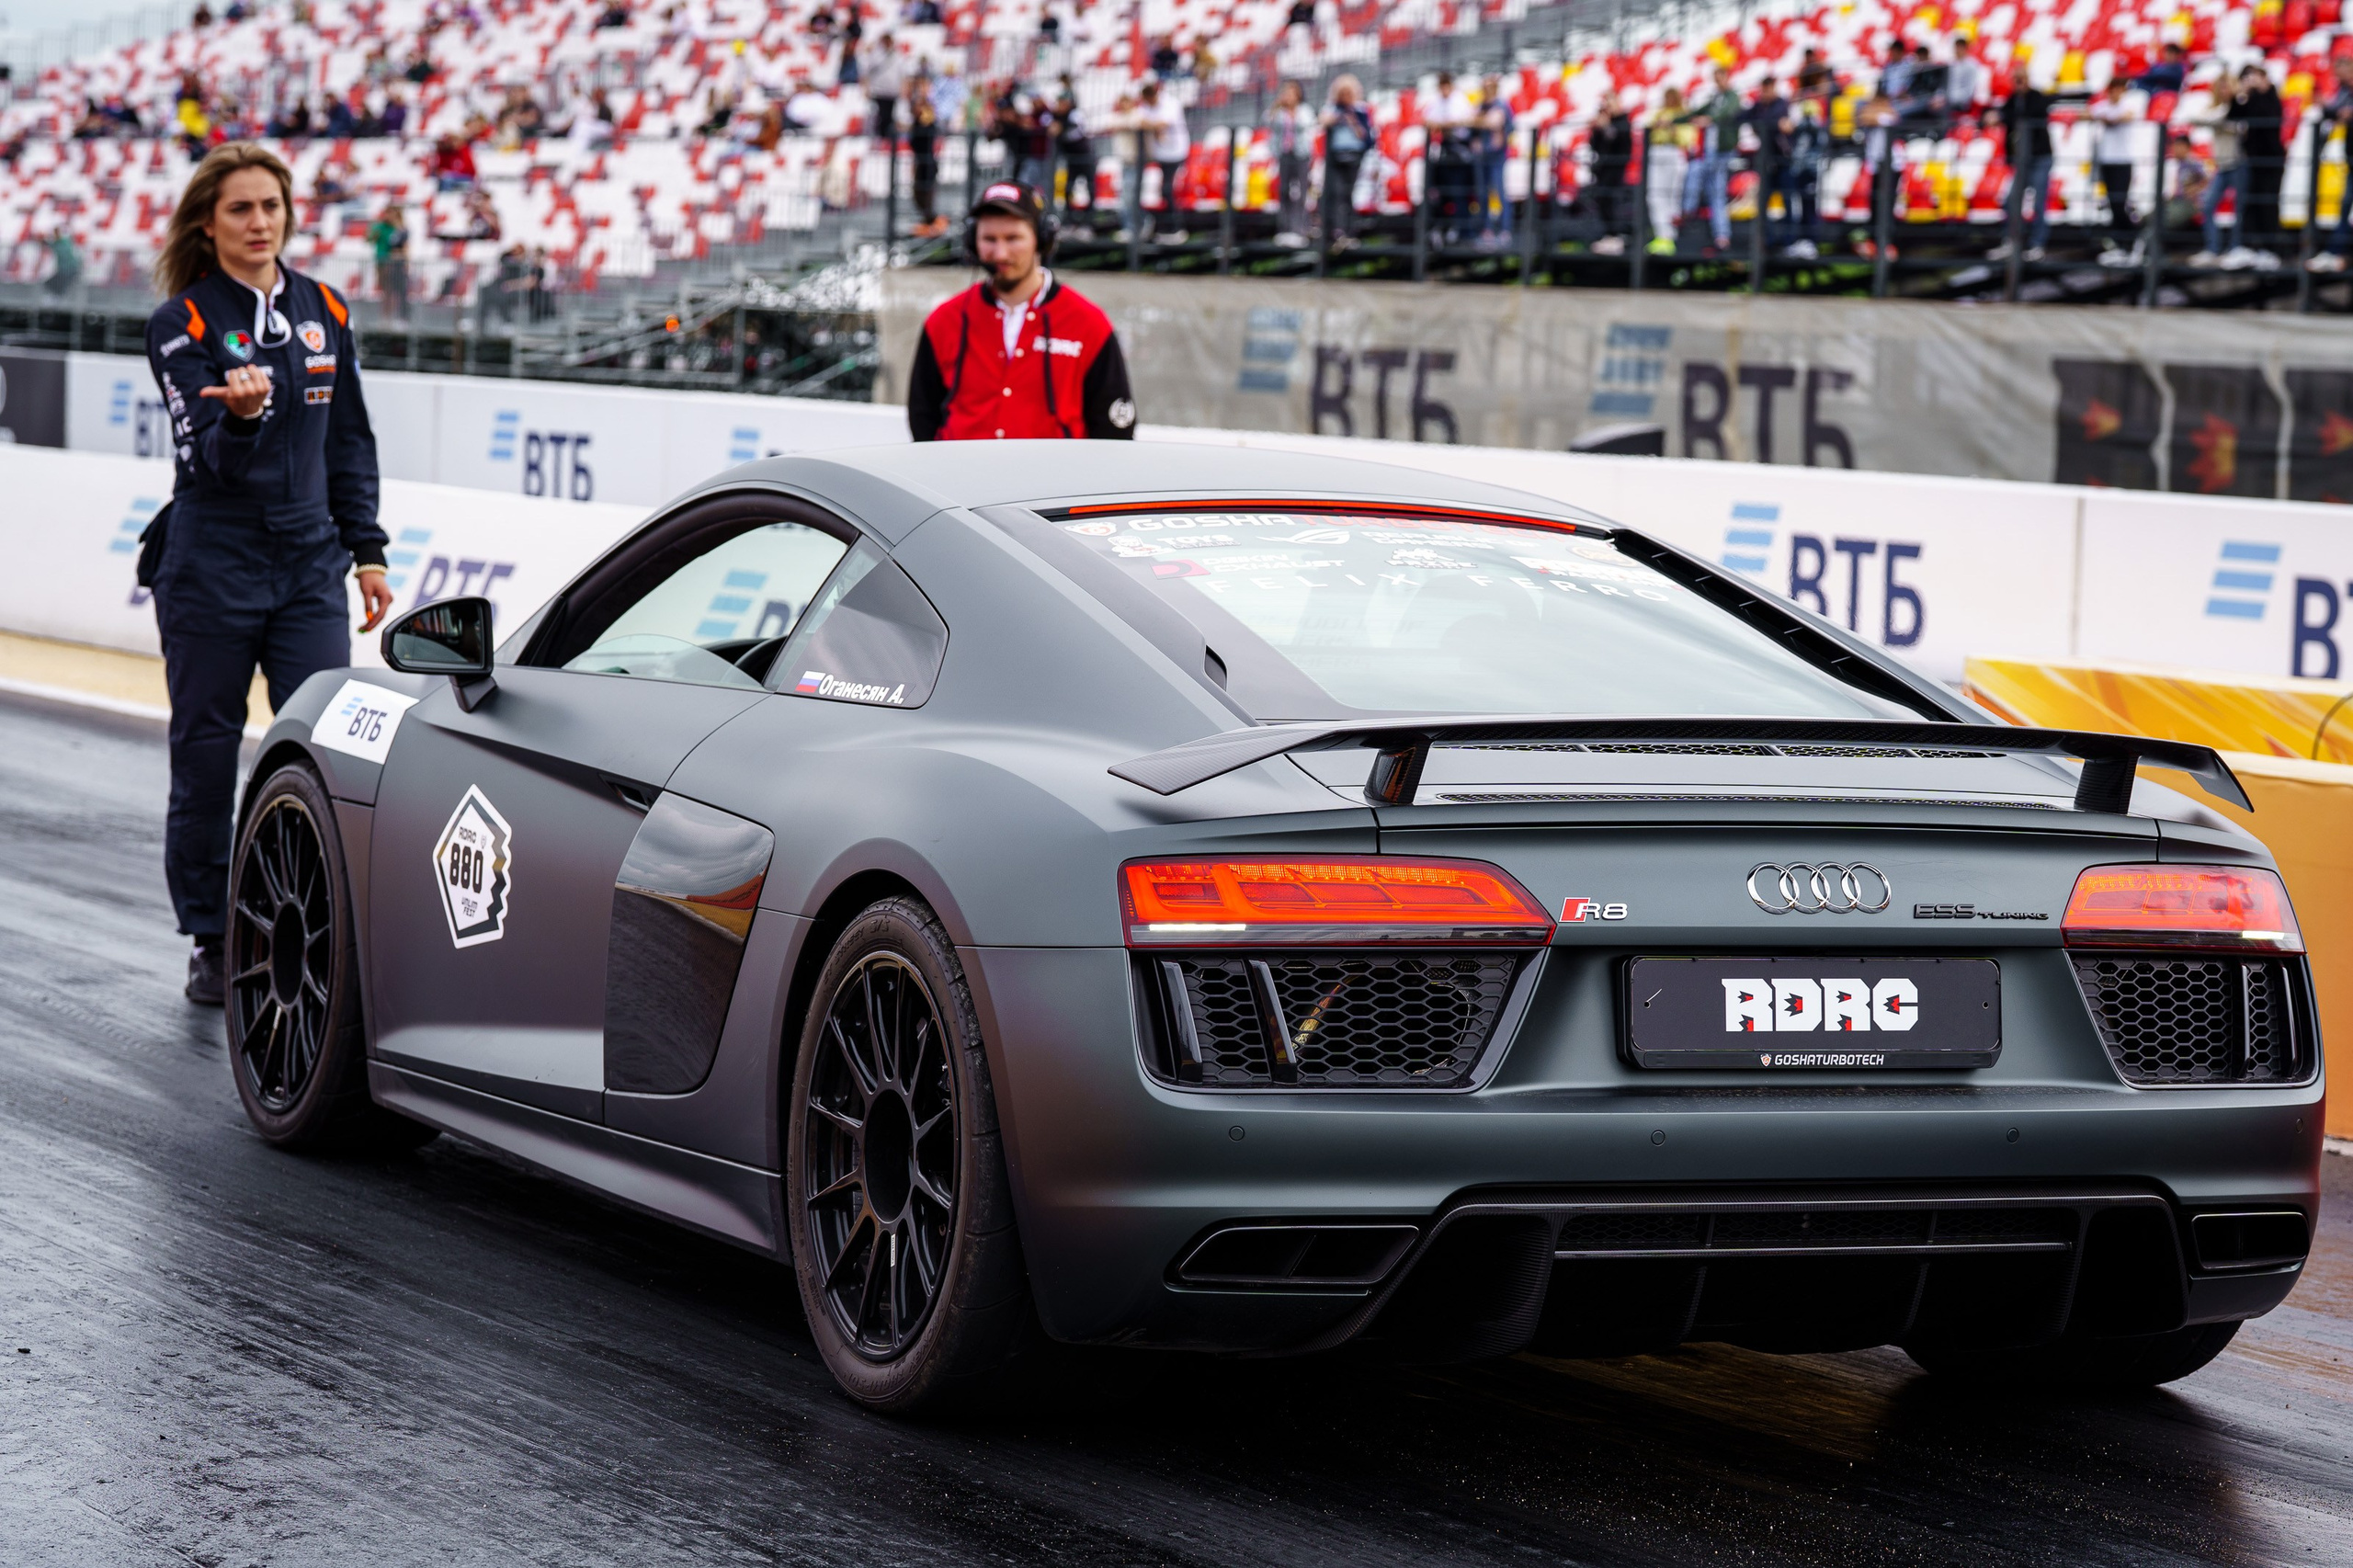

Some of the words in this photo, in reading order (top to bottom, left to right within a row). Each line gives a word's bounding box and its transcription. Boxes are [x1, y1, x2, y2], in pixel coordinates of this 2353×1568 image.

[523, 432, 595, 502] ВТБ
[1205, 573, 1422, 594] FELIX
[1467, 574, 1670, 602] FERRO
[1790, 535, 1924, 647] ВТБ
[2292, 577, 2353, 679] В
[819, 674, 890, 702] Оганесян
[347, 707, 388, 742] ВТБ
[449, 842, 483, 894] 880
[463, 905, 476, 917] FEST
[1574, 903, 1628, 921] R8
[1914, 903, 1976, 919] ESS
[1977, 911, 2049, 920] TUNING
[1721, 978, 1919, 1032] RDRC
[1774, 1054, 1885, 1067] GOSHATURBOTECH
